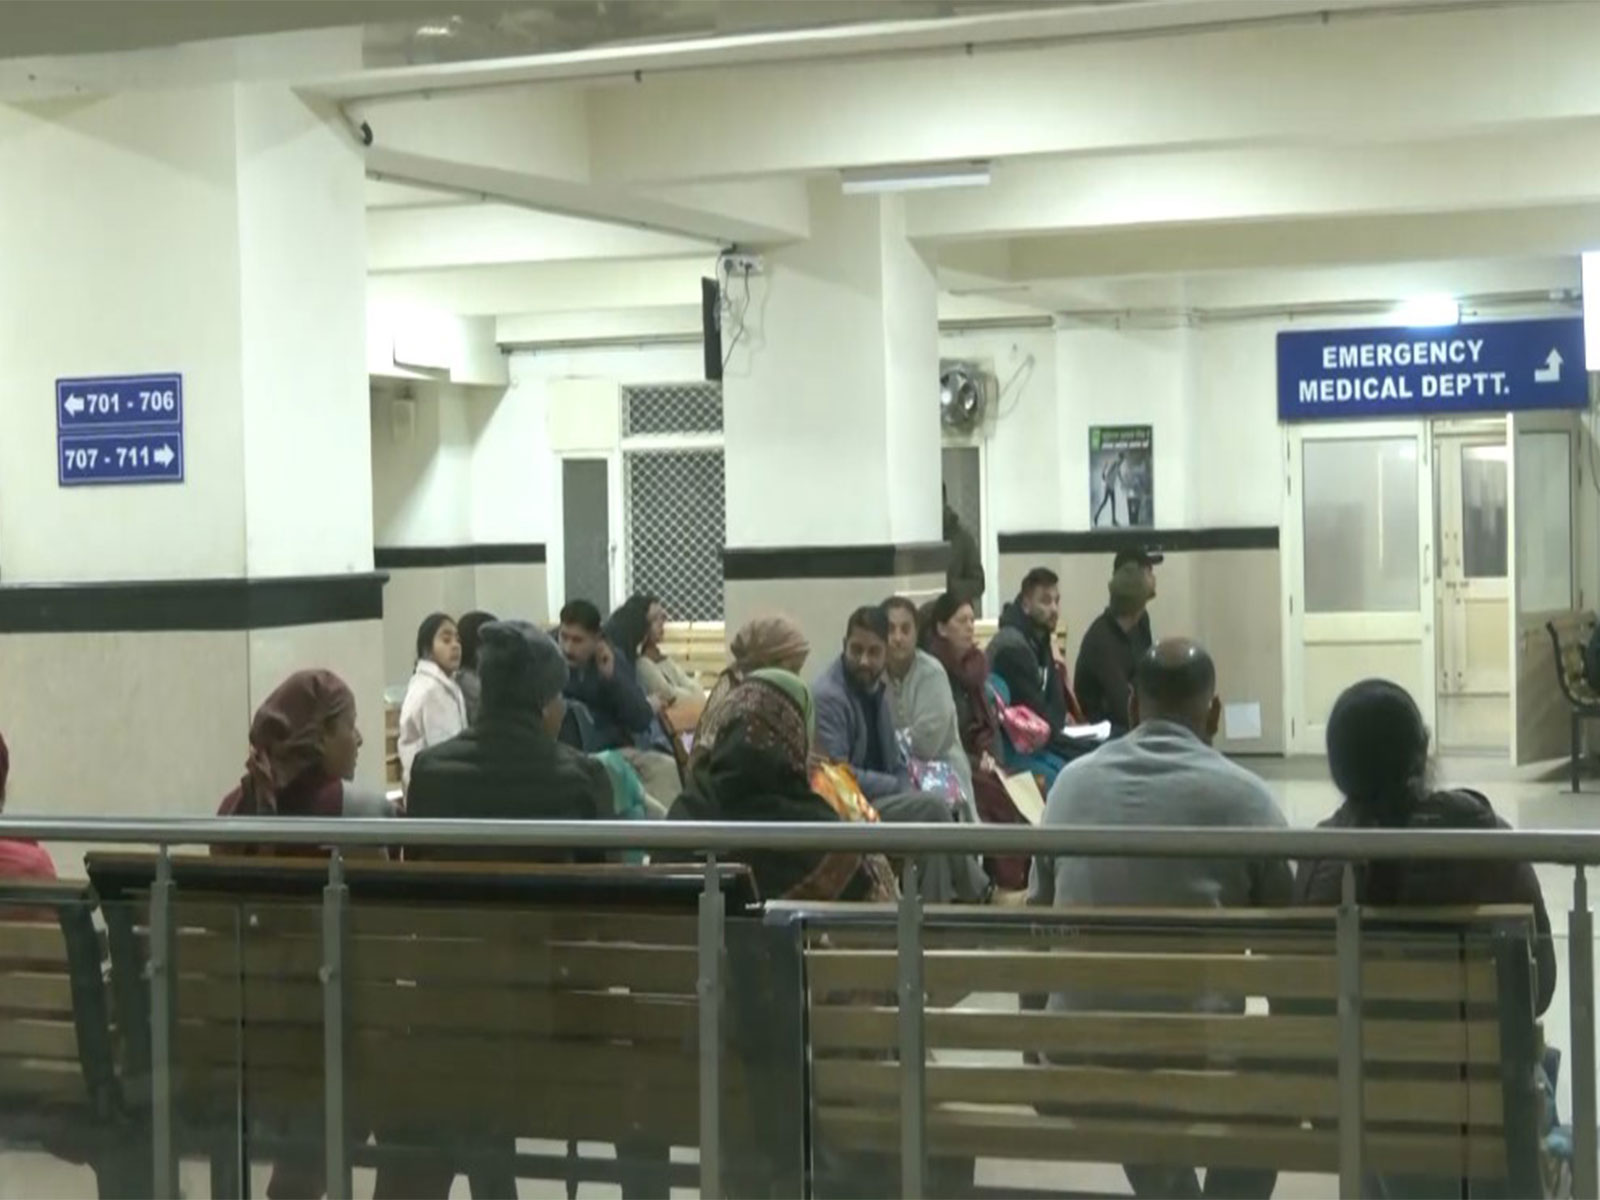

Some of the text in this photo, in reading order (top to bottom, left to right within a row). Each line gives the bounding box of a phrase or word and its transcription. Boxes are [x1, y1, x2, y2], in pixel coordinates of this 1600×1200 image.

[1322, 339, 1484, 369] EMERGENCY
[1299, 372, 1510, 403] MEDICAL DEPTT.
[86, 393, 120, 414] 701
[139, 390, 175, 412] 706
[64, 448, 98, 470] 707
[116, 446, 149, 467] 711
